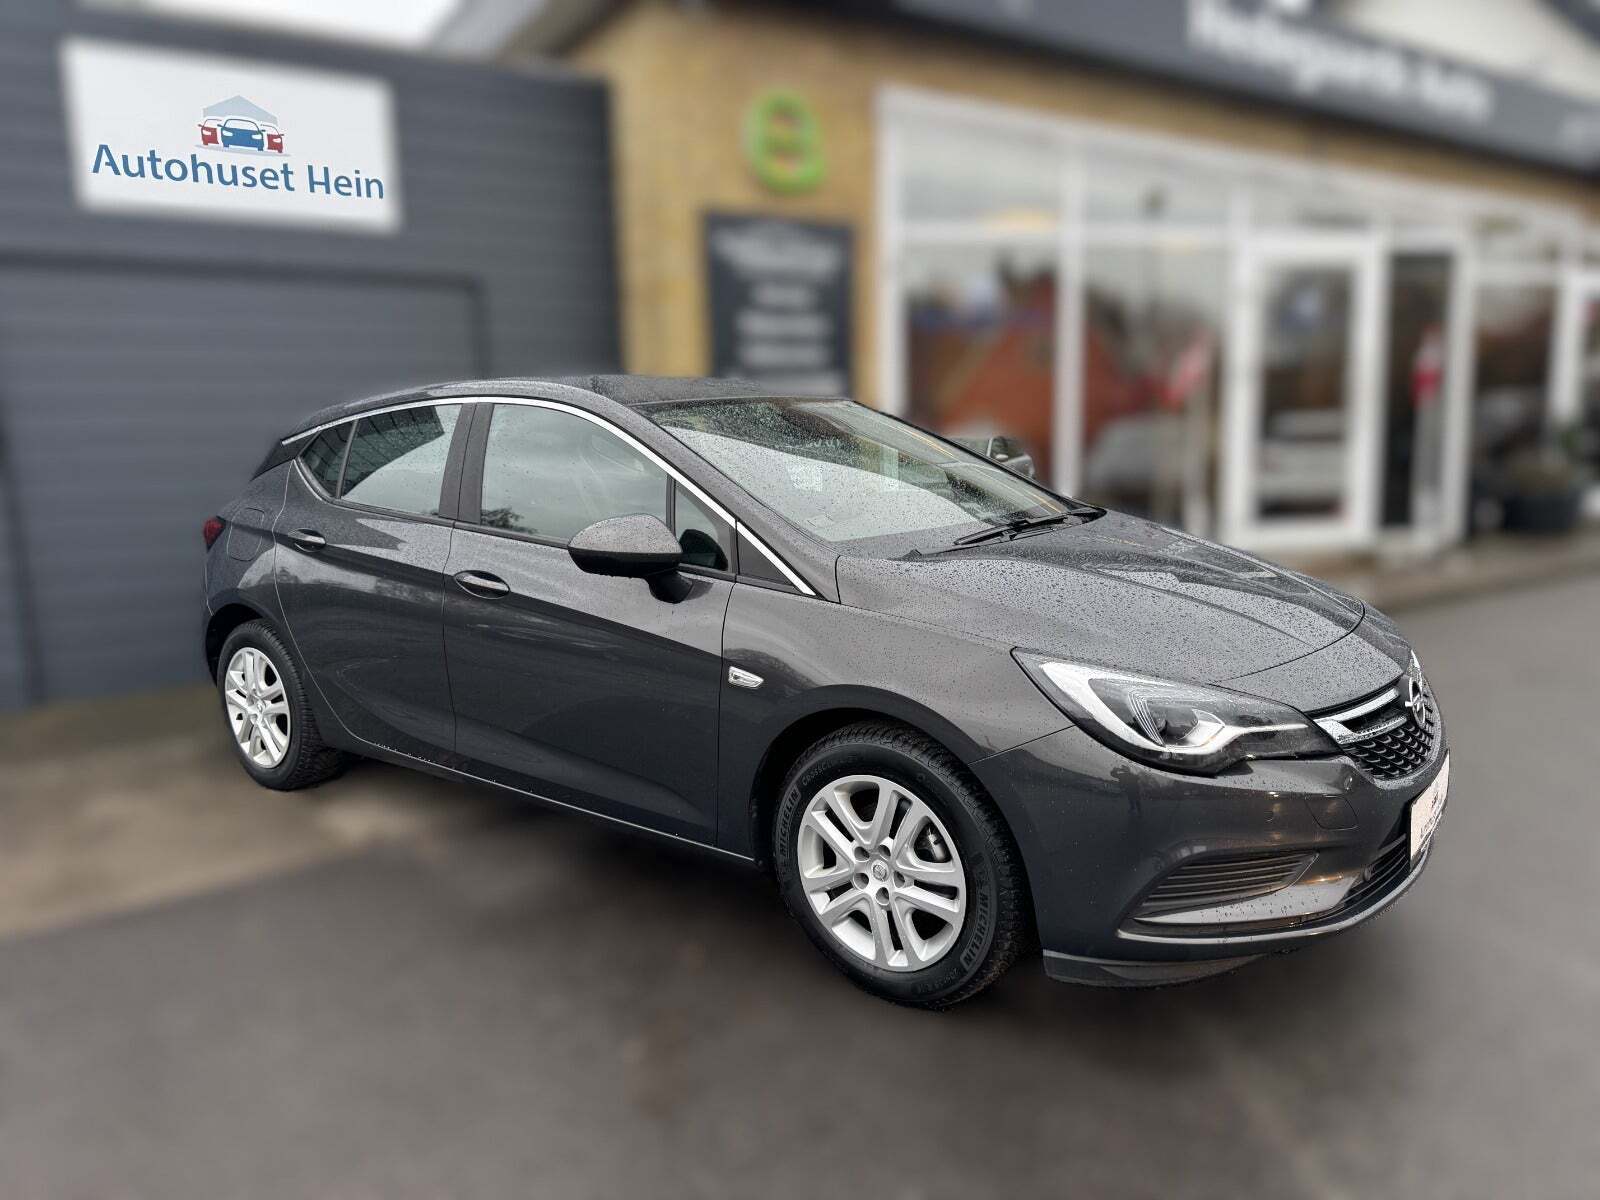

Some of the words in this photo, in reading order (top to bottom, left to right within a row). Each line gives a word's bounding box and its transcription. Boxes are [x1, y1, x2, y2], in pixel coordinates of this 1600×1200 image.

[92, 143, 296, 192] Autohuset
[306, 164, 384, 200] Hein
[779, 789, 799, 857] MICHELIN
[963, 892, 989, 967] MICHELIN
